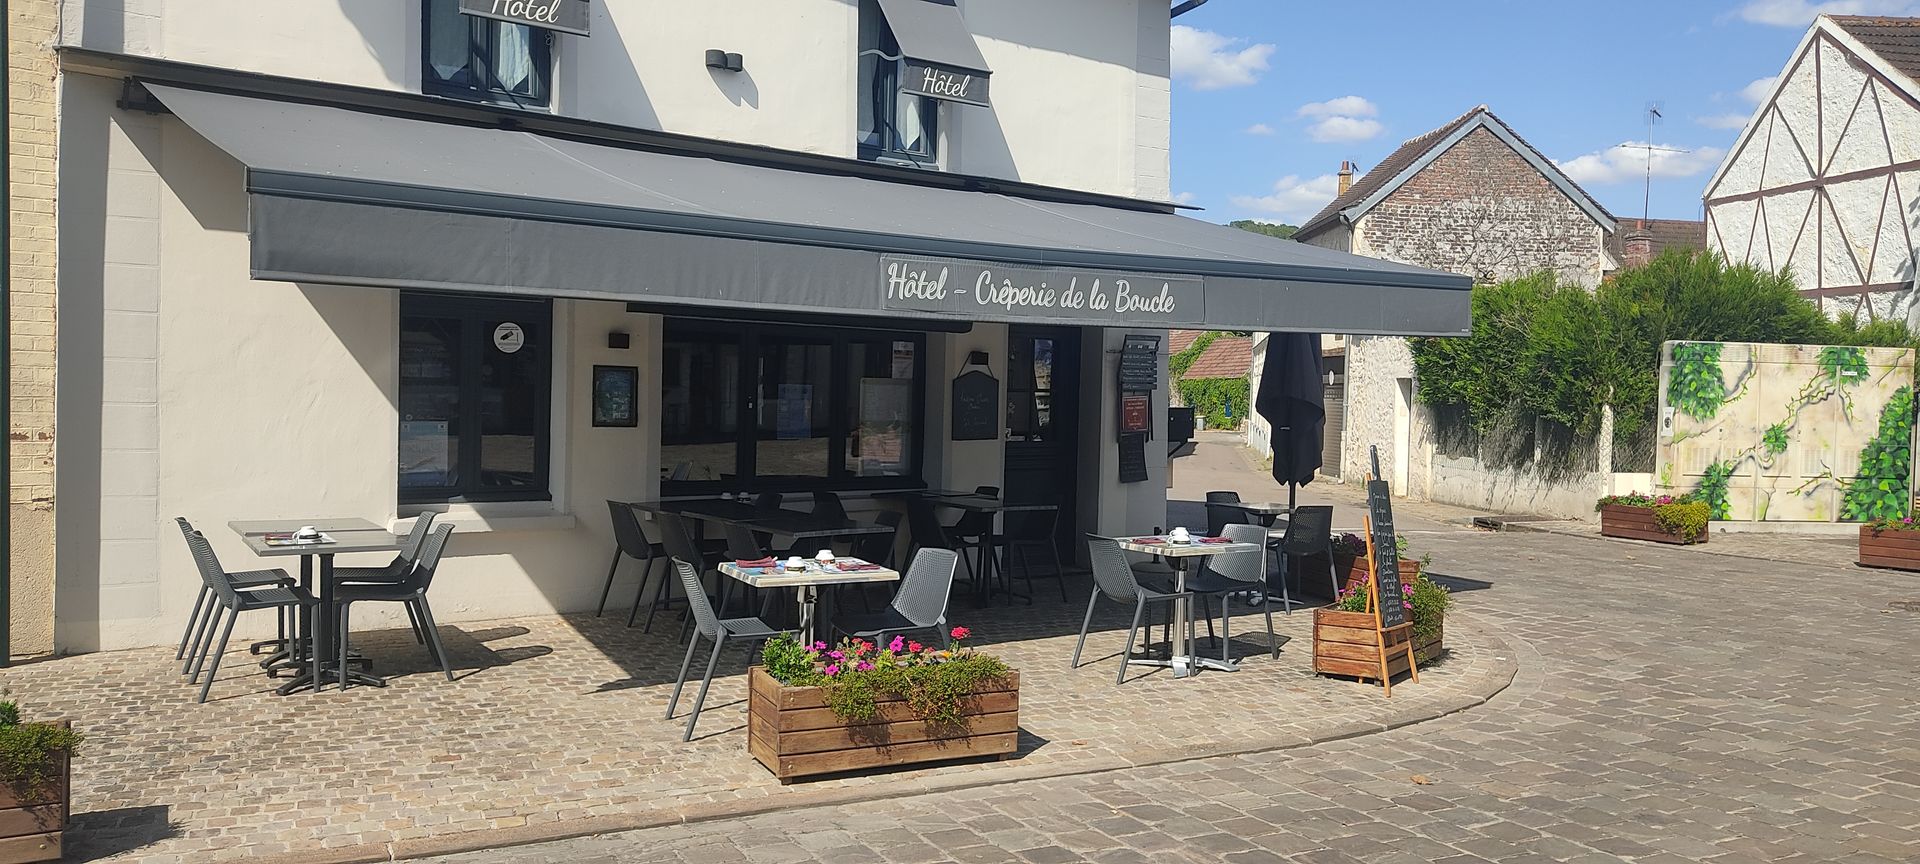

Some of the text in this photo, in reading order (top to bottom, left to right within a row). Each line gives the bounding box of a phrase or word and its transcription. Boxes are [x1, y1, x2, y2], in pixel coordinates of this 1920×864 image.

[922, 66, 971, 97] Hôtel
[887, 262, 948, 300] Hôtel
[974, 269, 1056, 311] Crêperie
[1060, 276, 1085, 309] de
[1088, 278, 1109, 311] la
[1114, 278, 1176, 314] Boucle
